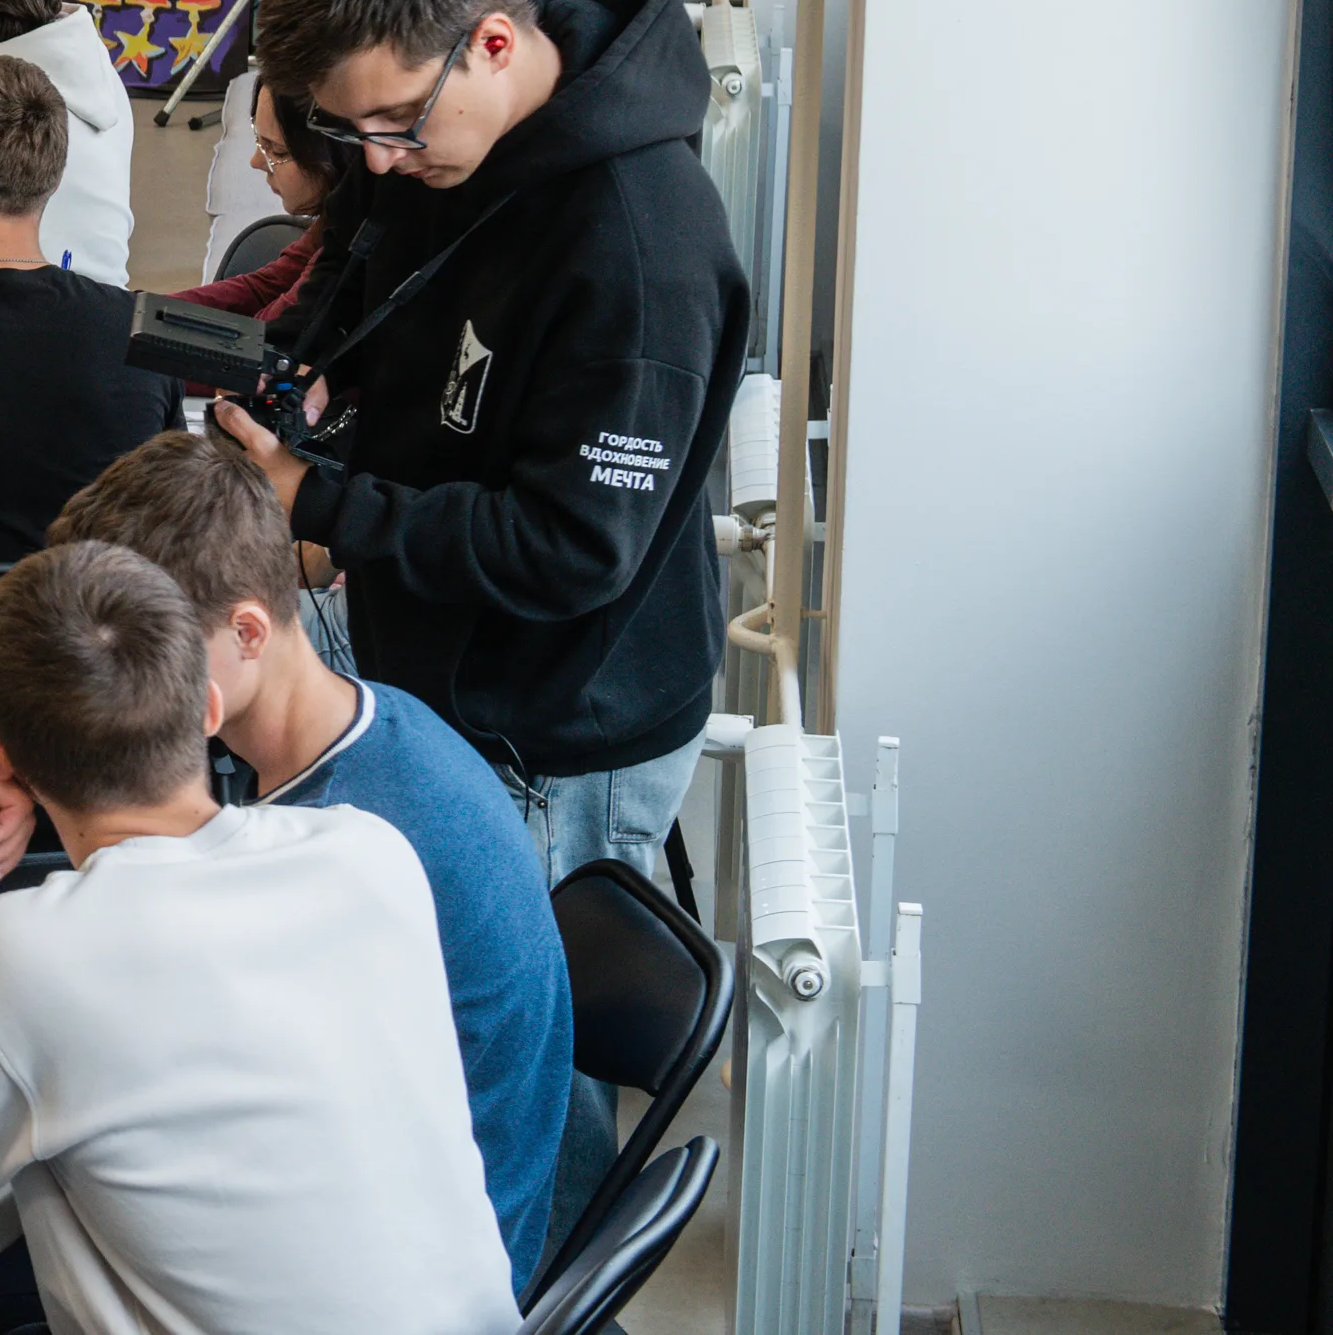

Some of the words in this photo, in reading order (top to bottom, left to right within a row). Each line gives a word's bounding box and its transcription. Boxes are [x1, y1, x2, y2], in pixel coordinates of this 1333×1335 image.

[598, 431, 663, 453] ГОРДОСТЬ
[579, 444, 670, 470] ВДОХНОВЕНИЕ
[589, 465, 655, 491] МЕЧТА
